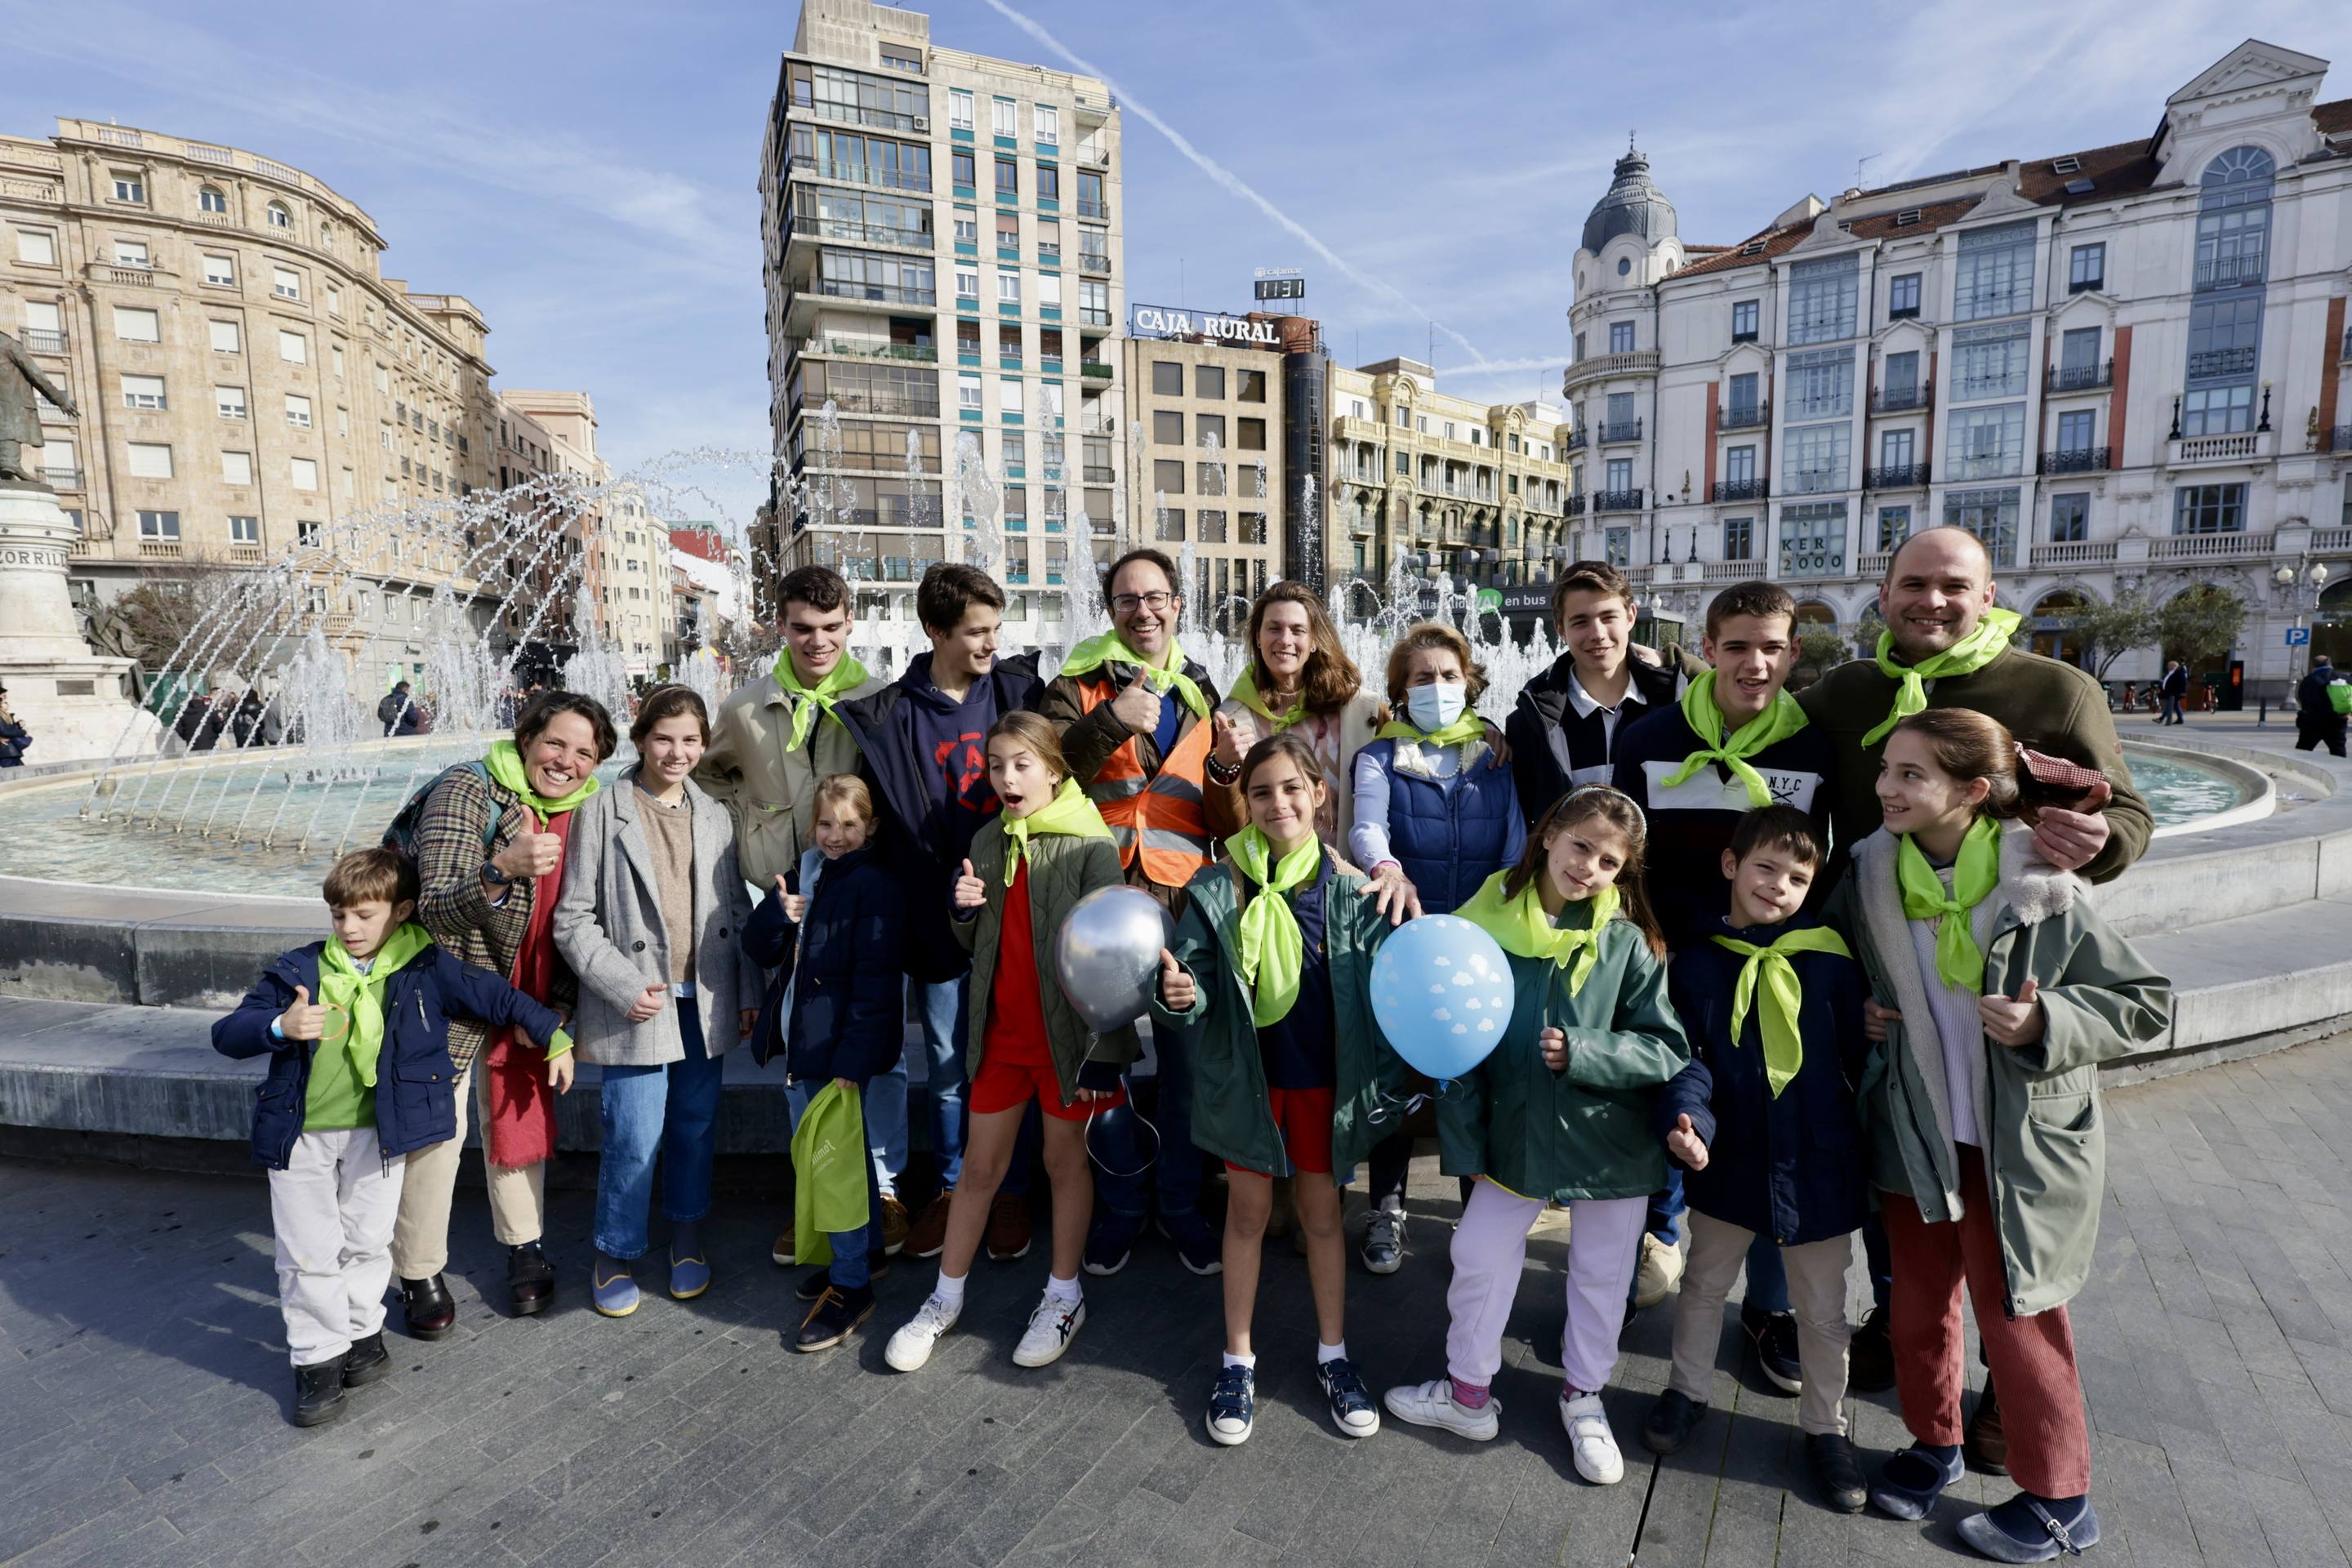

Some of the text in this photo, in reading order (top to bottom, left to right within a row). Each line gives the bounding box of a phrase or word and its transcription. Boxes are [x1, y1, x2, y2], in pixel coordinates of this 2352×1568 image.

[1136, 310, 1281, 344] CAJA RURAL
[1782, 537, 1824, 551] KER
[1784, 555, 1842, 571] 2000
[1504, 598, 1520, 607] en
[1523, 594, 1547, 606] bus
[2290, 630, 2305, 644] P
[1768, 776, 1802, 791] N.Y.C
